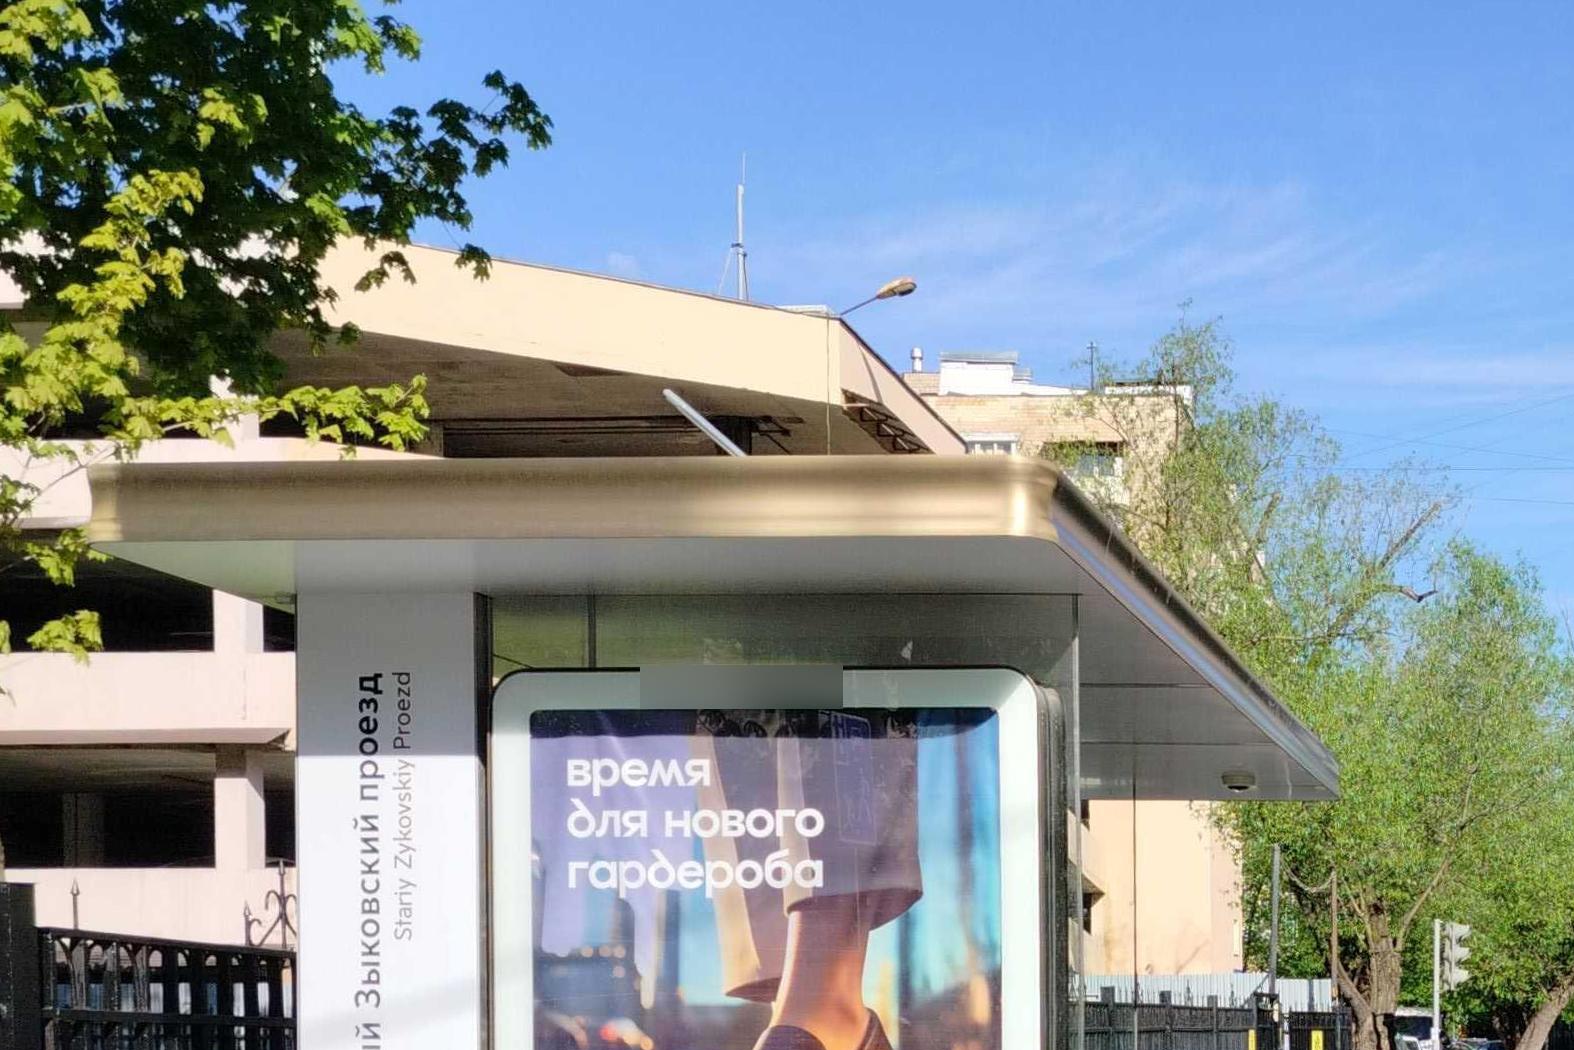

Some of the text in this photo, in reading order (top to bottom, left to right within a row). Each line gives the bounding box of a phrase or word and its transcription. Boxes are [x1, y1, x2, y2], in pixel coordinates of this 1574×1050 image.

[358, 673, 385, 800] проезд
[566, 757, 711, 797] время
[391, 671, 417, 940] Stariy Zykovskiy Proezd
[566, 798, 825, 839] для нового
[353, 814, 381, 1008] Зыковский
[567, 849, 824, 898] гардероба
